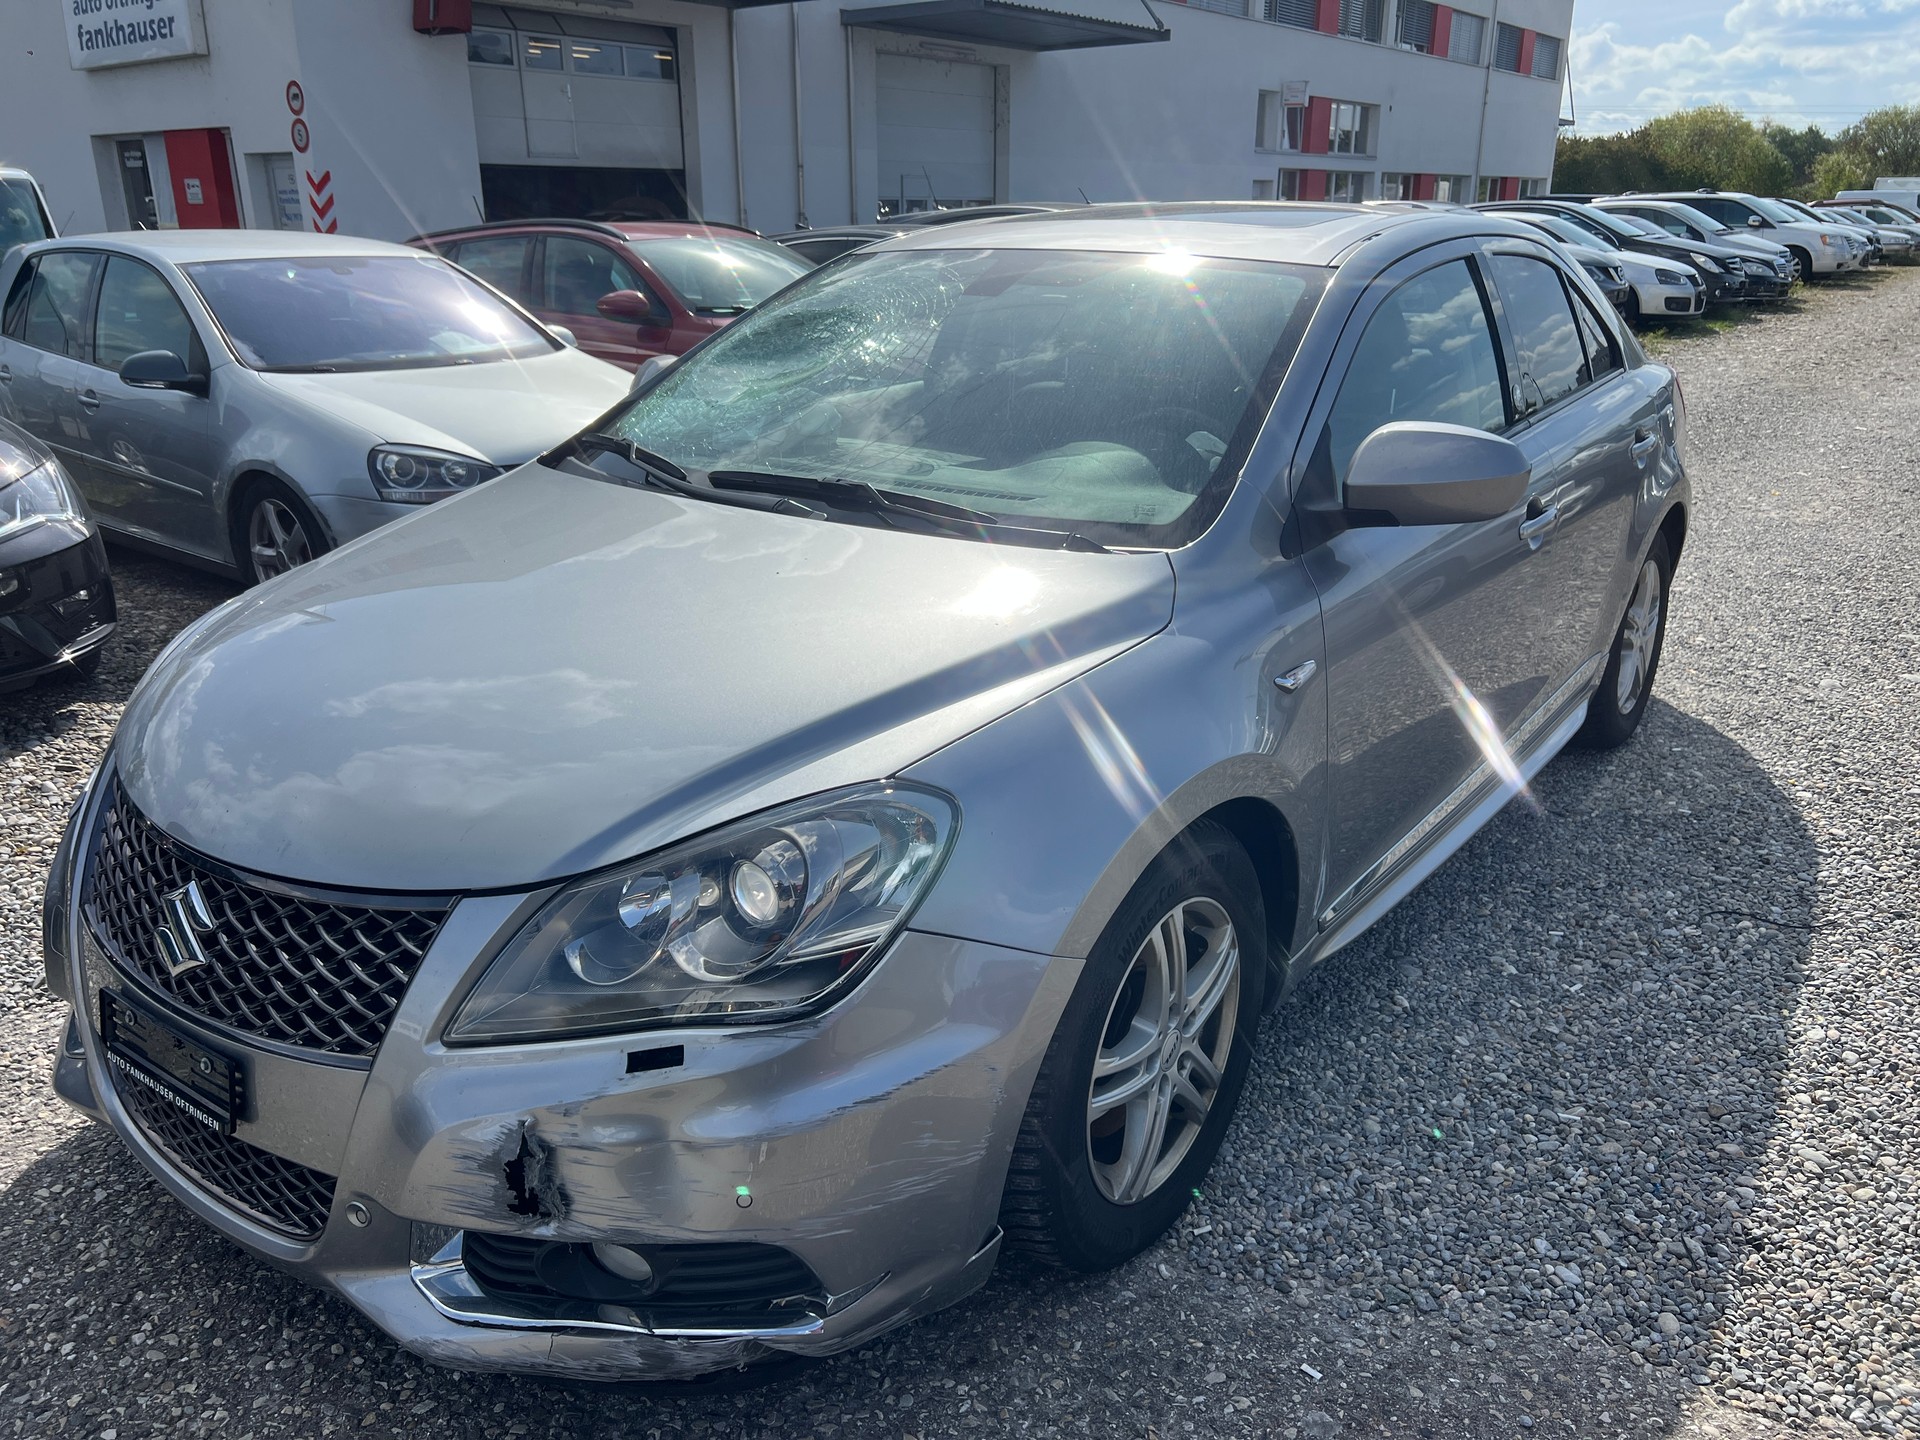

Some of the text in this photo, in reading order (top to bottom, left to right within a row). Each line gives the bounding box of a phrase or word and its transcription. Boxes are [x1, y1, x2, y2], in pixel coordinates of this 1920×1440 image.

[73, 0, 102, 17] auto
[77, 15, 175, 52] fankhauser
[297, 128, 304, 143] 5
[107, 1050, 219, 1131] AUTO FANKHAUSER OFTRINGEN
